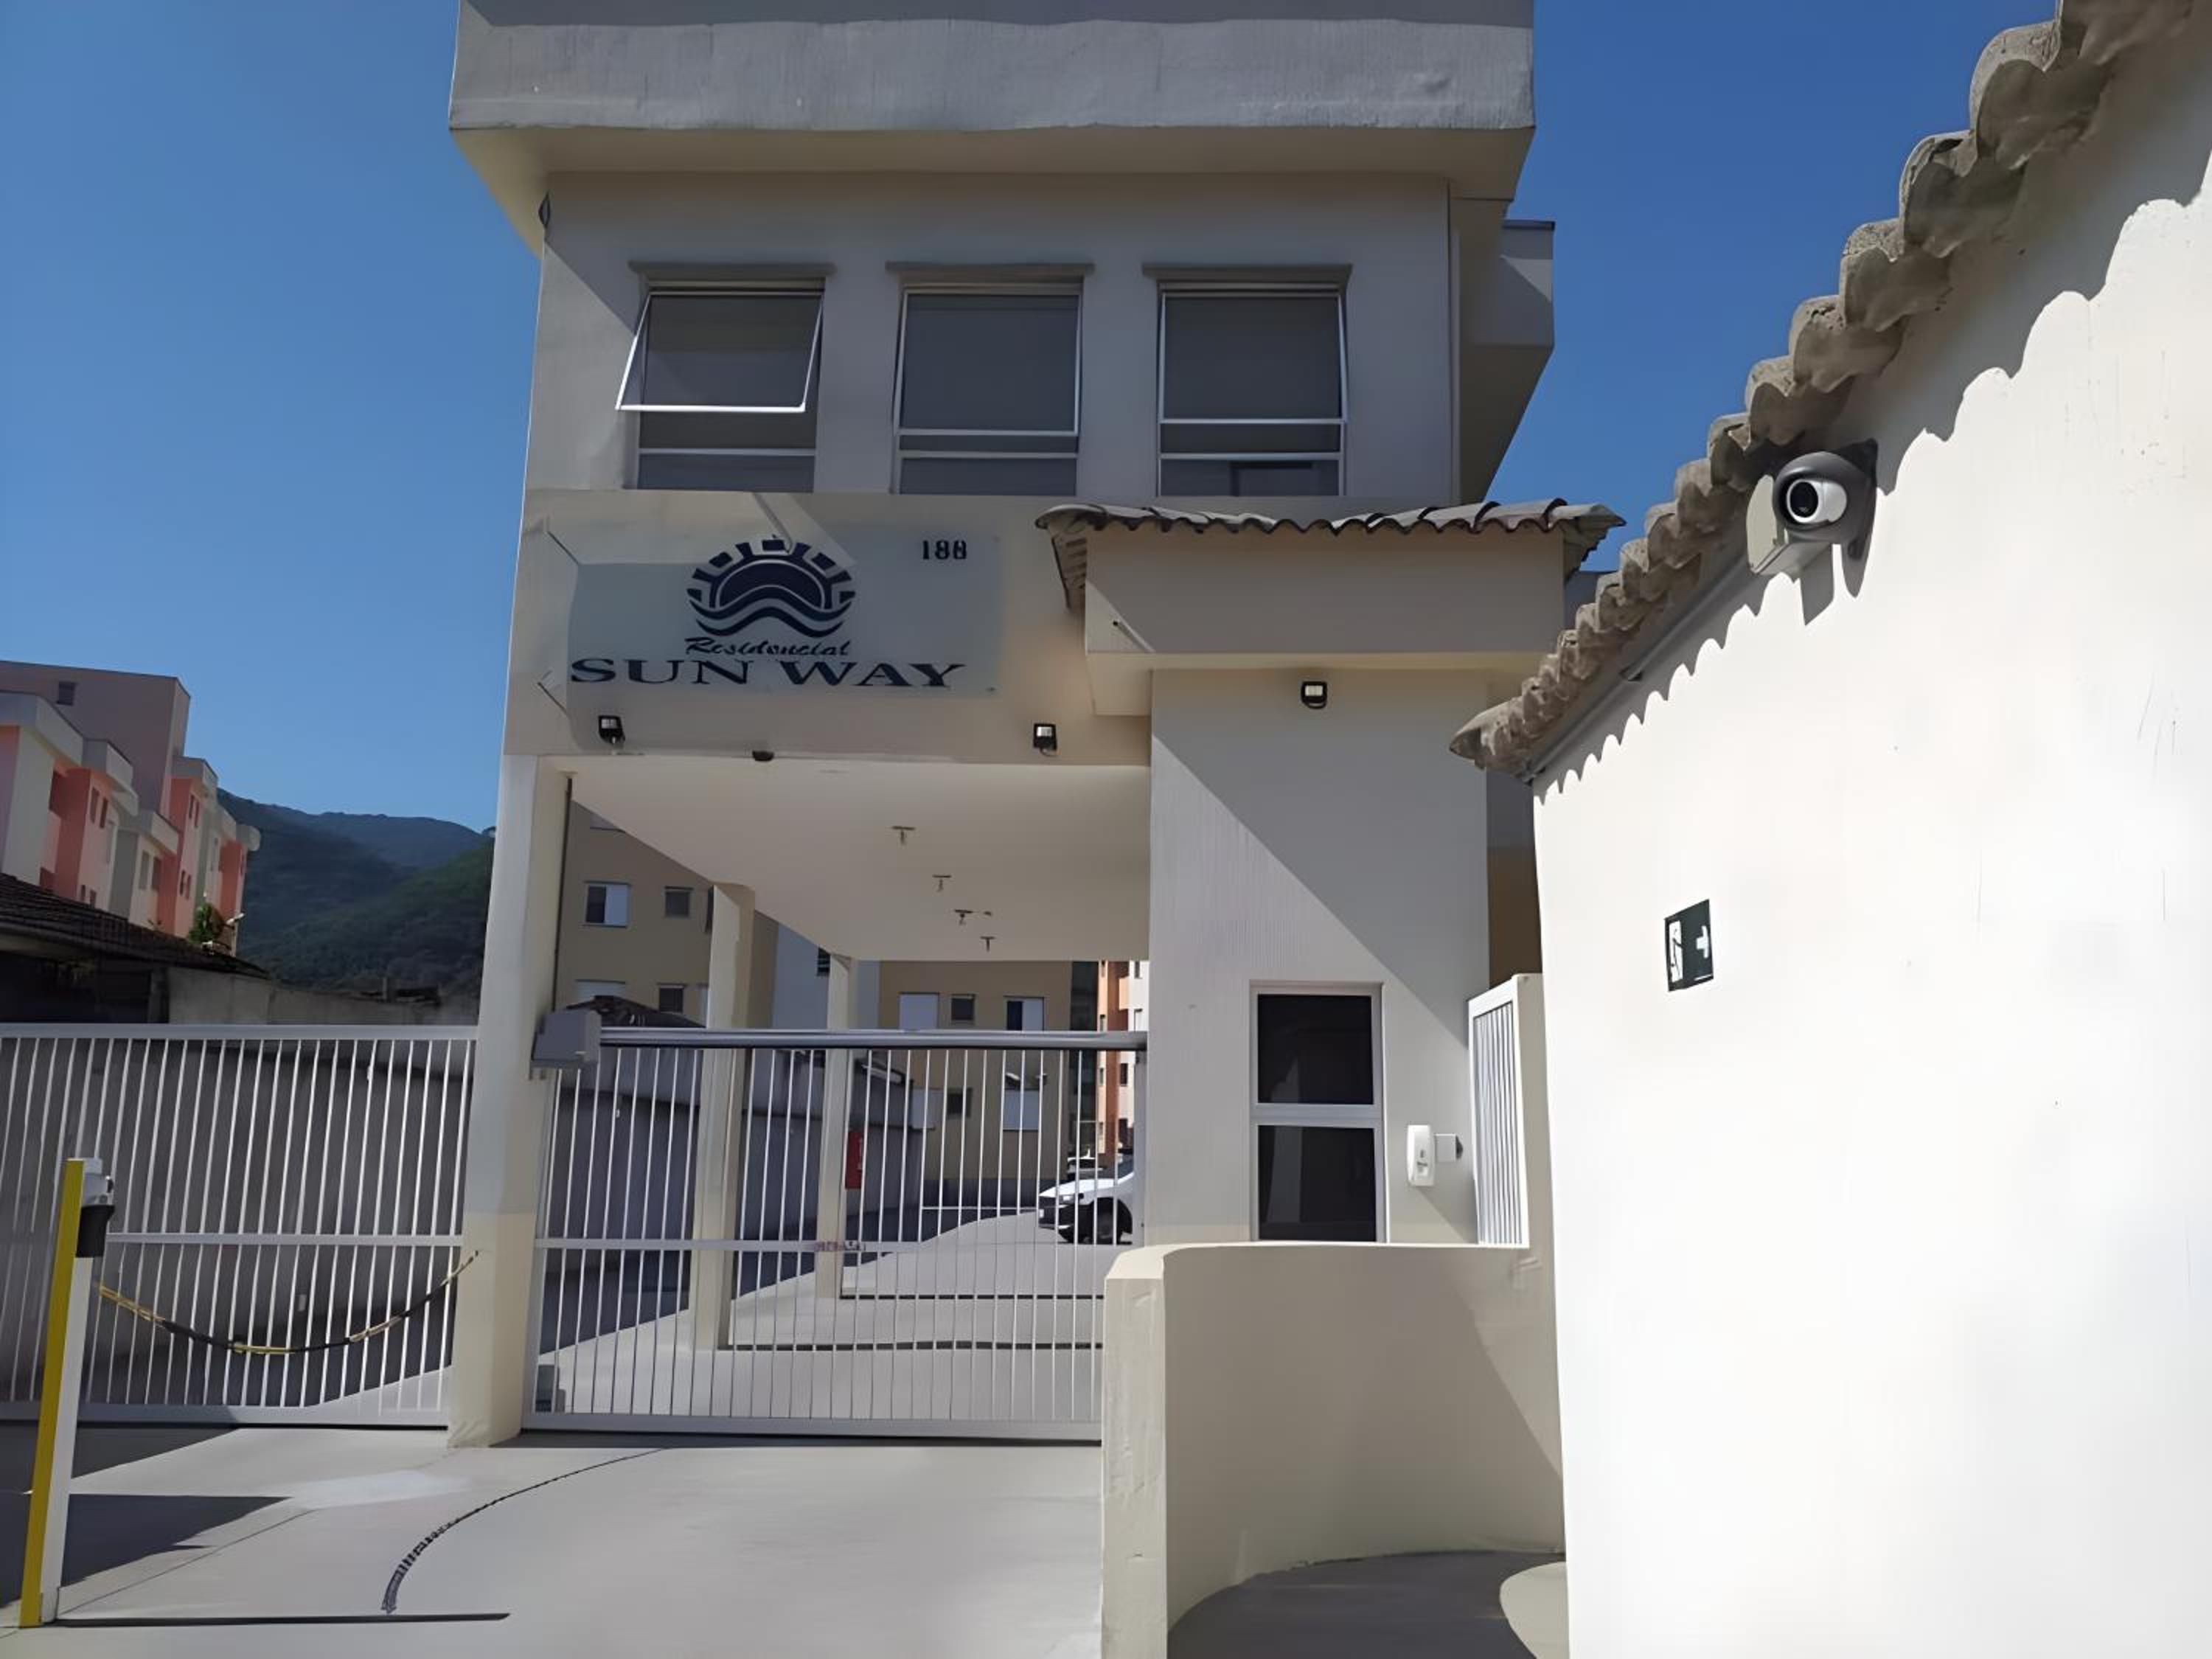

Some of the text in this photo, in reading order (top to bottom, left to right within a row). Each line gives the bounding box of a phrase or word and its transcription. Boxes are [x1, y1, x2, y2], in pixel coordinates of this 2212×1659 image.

[922, 539, 967, 560] 188
[684, 636, 851, 655] Residencial
[570, 658, 967, 688] SUN WAY
